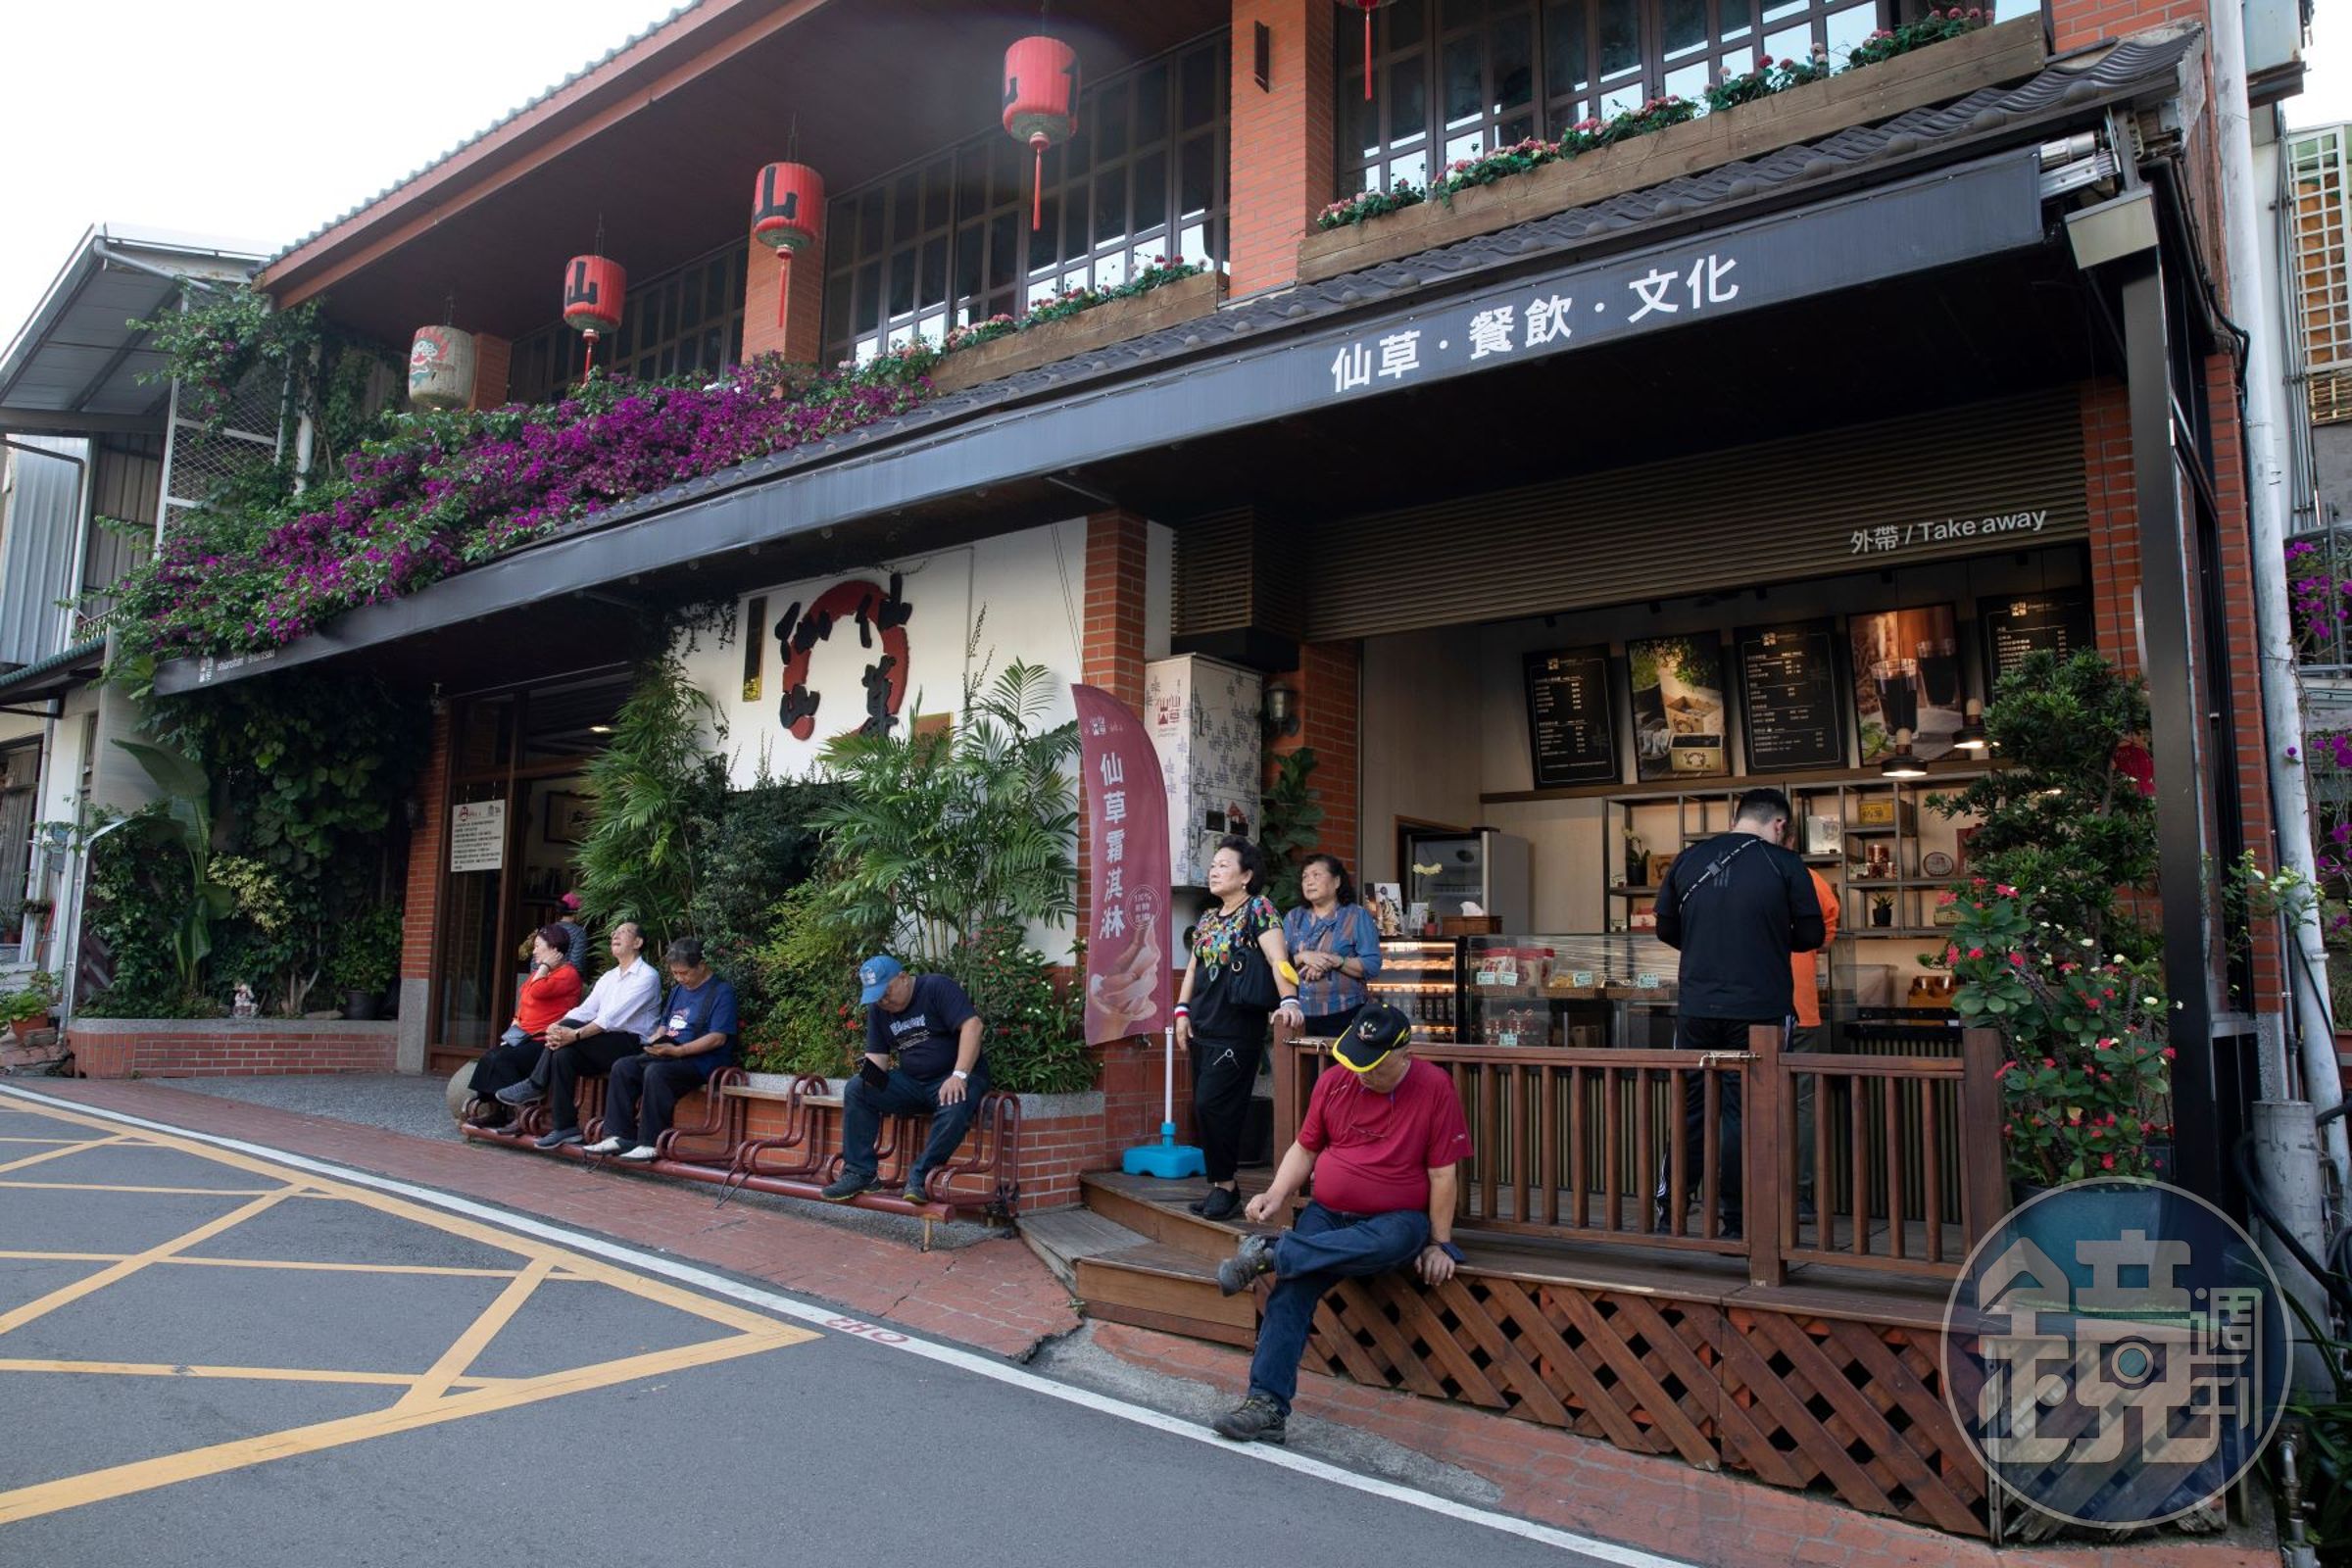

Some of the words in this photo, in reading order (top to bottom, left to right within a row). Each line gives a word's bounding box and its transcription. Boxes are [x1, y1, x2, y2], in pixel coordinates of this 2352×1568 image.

[1850, 525, 1898, 554] 外帶
[1918, 519, 1977, 543] Take
[1982, 510, 2047, 534] away
[1099, 752, 1127, 940] 仙草霜淇淋
